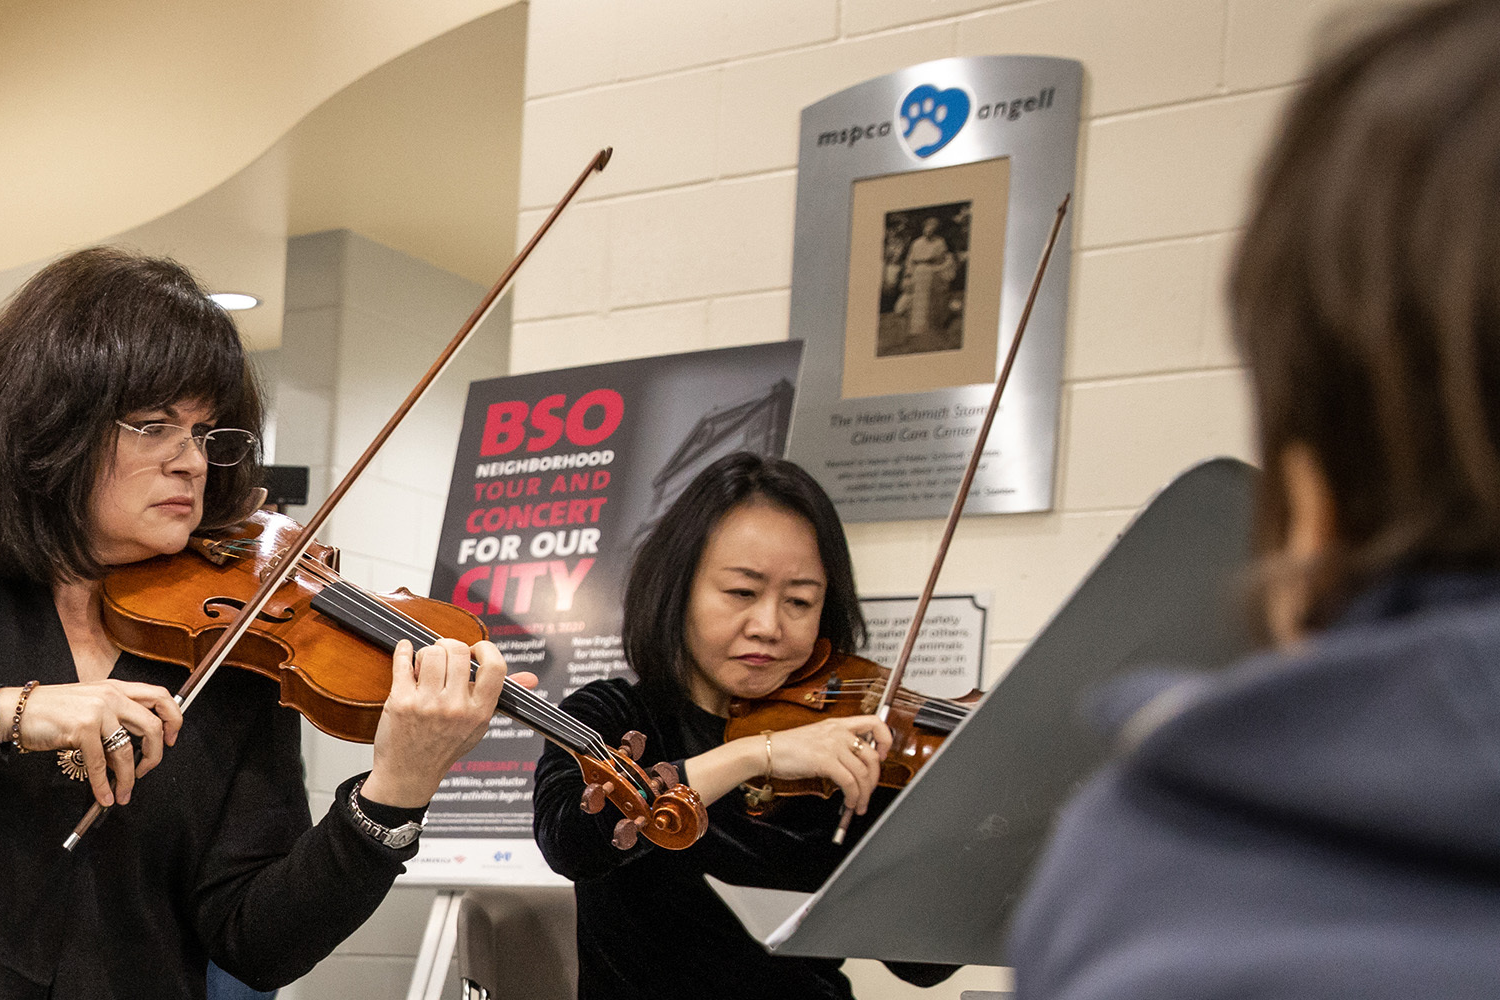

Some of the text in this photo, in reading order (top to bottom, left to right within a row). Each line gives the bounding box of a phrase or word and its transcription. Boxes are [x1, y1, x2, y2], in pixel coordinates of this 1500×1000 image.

[817, 87, 1056, 148] mspca angell
[480, 388, 625, 457] BSO
[830, 413, 851, 427] The
[856, 411, 894, 426] Helen
[852, 424, 977, 446] Clinical Care Center
[475, 450, 615, 478] NEIGHBORHOOD
[474, 470, 611, 502] TOUR AND
[465, 497, 607, 534] CONCERT
[457, 528, 601, 565] FOR OUR
[452, 557, 597, 617] CITY
[572, 637, 592, 646] New
[877, 629, 906, 640] safet
[510, 639, 546, 651] Hospital
[566, 660, 611, 674] Spaulding
[491, 728, 515, 739] Music
[517, 728, 535, 738] and
[451, 776, 484, 788] Wilkins,
[484, 776, 528, 787] conductor
[462, 790, 498, 801] activities
[499, 790, 522, 803] begin
